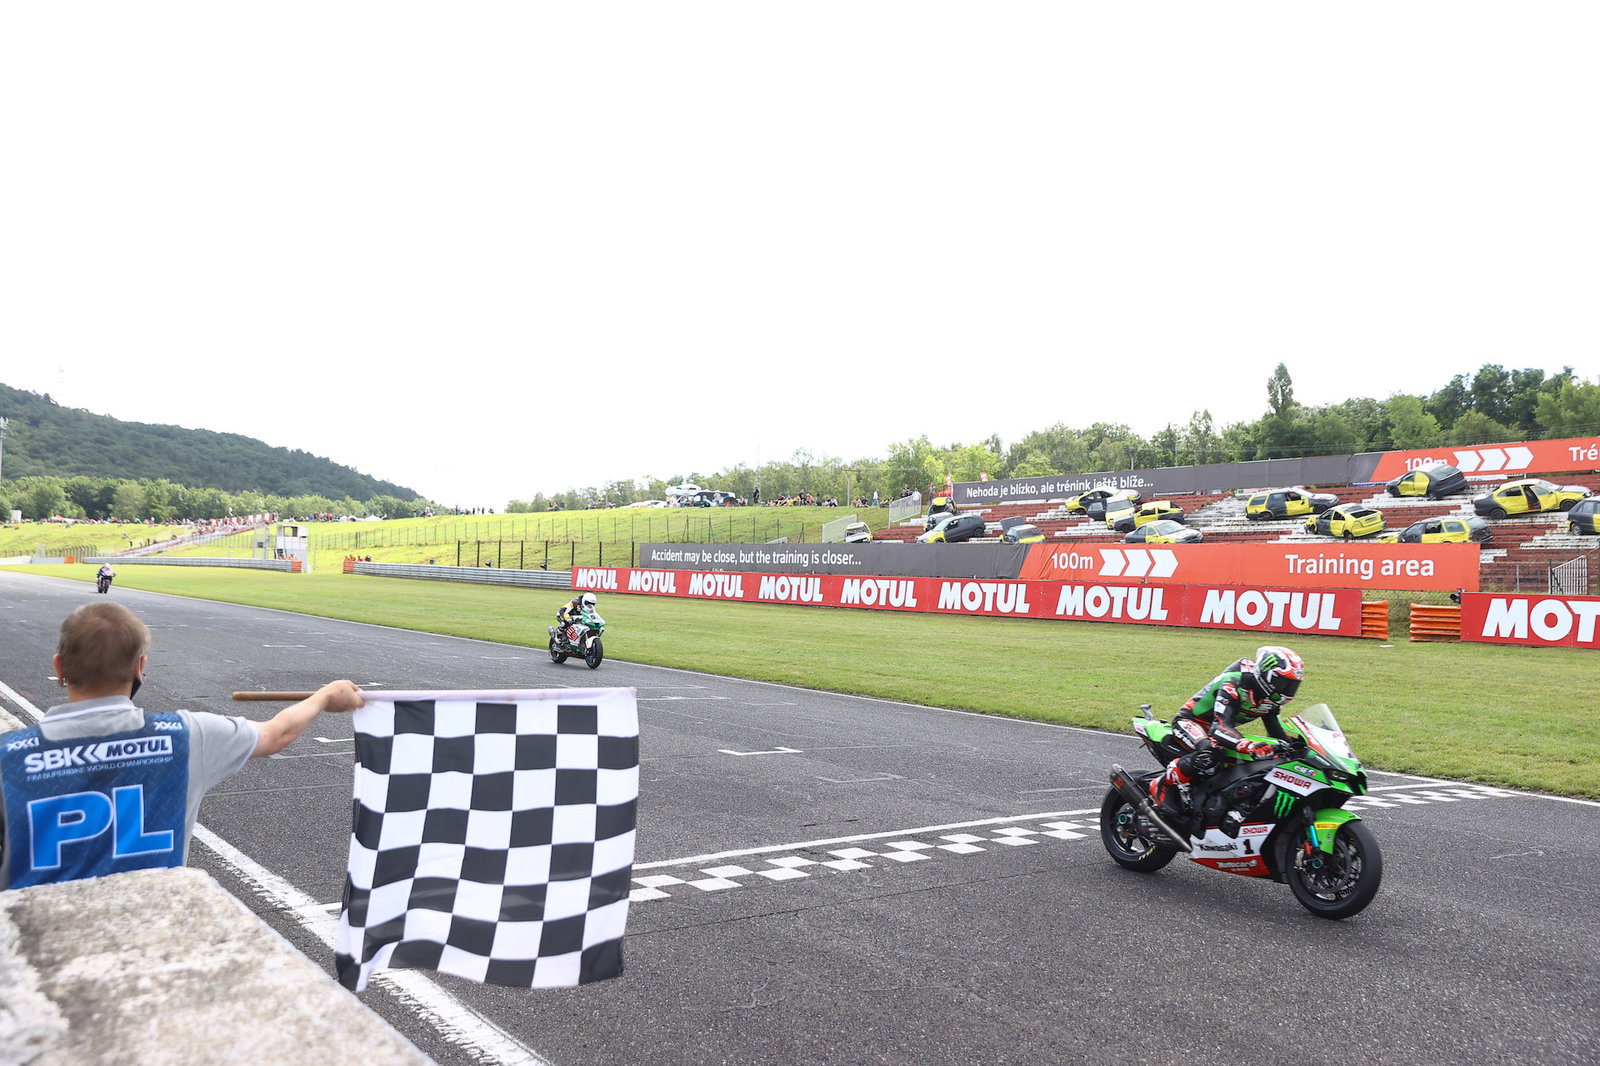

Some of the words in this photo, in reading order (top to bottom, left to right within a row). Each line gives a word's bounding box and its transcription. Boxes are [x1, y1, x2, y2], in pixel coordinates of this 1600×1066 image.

[966, 485, 999, 498] Nehoda
[1000, 486, 1009, 498] je
[1010, 483, 1039, 496] blízko,
[1041, 481, 1055, 493] ale
[1056, 478, 1091, 492] trénink
[1120, 474, 1154, 489] blíže...
[651, 549, 683, 562] Accident
[684, 552, 701, 565] may
[701, 550, 713, 563] be
[713, 550, 738, 565] close,
[739, 550, 754, 564] but
[755, 550, 770, 564] the
[772, 550, 809, 567] training
[811, 550, 820, 565] is
[821, 550, 862, 566] closer...
[1051, 552, 1094, 570] 100m
[1284, 553, 1374, 580] Training
[1380, 559, 1434, 577] area
[576, 568, 618, 590] MOTUL
[628, 570, 677, 594] MOTUL
[688, 573, 744, 598] MOTUL
[758, 575, 824, 602] MOTUL
[840, 578, 917, 608] MOTUL
[938, 581, 1030, 614] MOTUL
[1056, 585, 1169, 621] MOTUL
[1200, 589, 1341, 630] MOTUL
[1481, 598, 1600, 643] MOT
[24, 747, 85, 774] SBK
[106, 739, 170, 758] MOTUL
[87, 763, 116, 773] WORLD
[117, 756, 174, 769] CHAMPIONSHIP
[1273, 771, 1312, 789] SHOWA
[27, 784, 174, 871] PL
[1198, 842, 1239, 852] Kawasaki
[1243, 838, 1255, 855] 1
